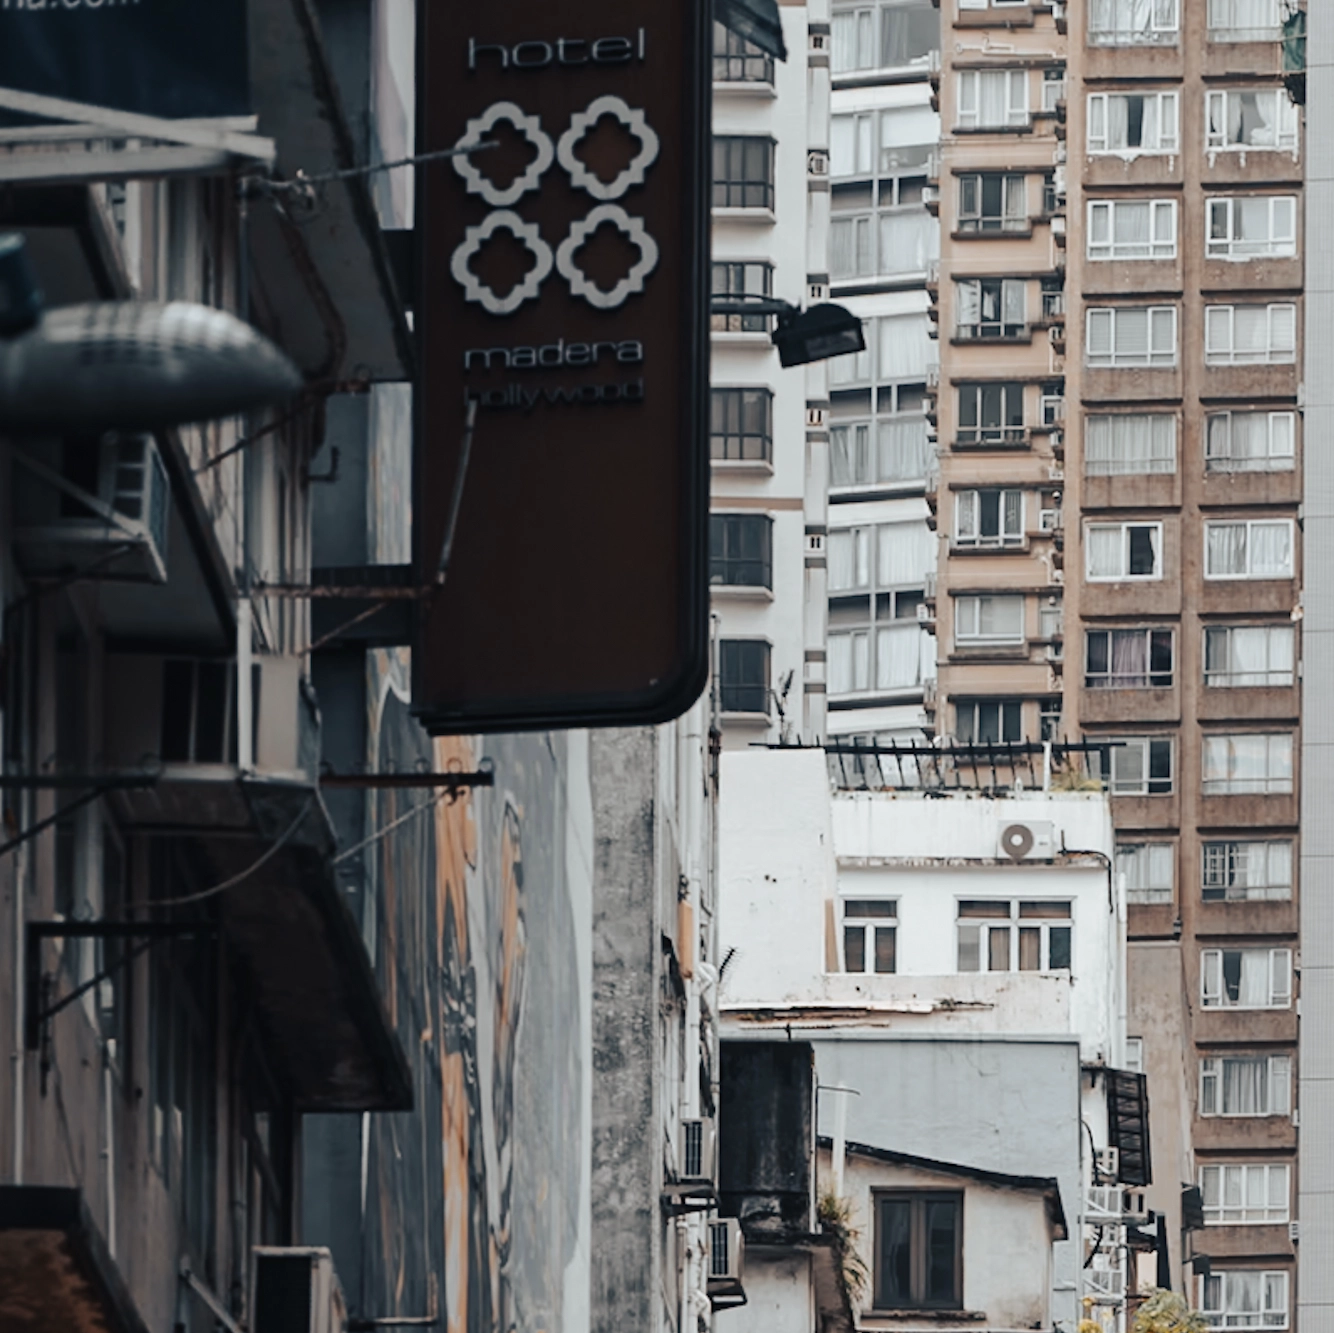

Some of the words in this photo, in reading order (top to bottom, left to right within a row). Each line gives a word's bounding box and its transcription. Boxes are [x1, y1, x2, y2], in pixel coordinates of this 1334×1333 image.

[467, 28, 646, 70] hotel
[464, 338, 644, 369] madera
[463, 378, 645, 410] hollywood
